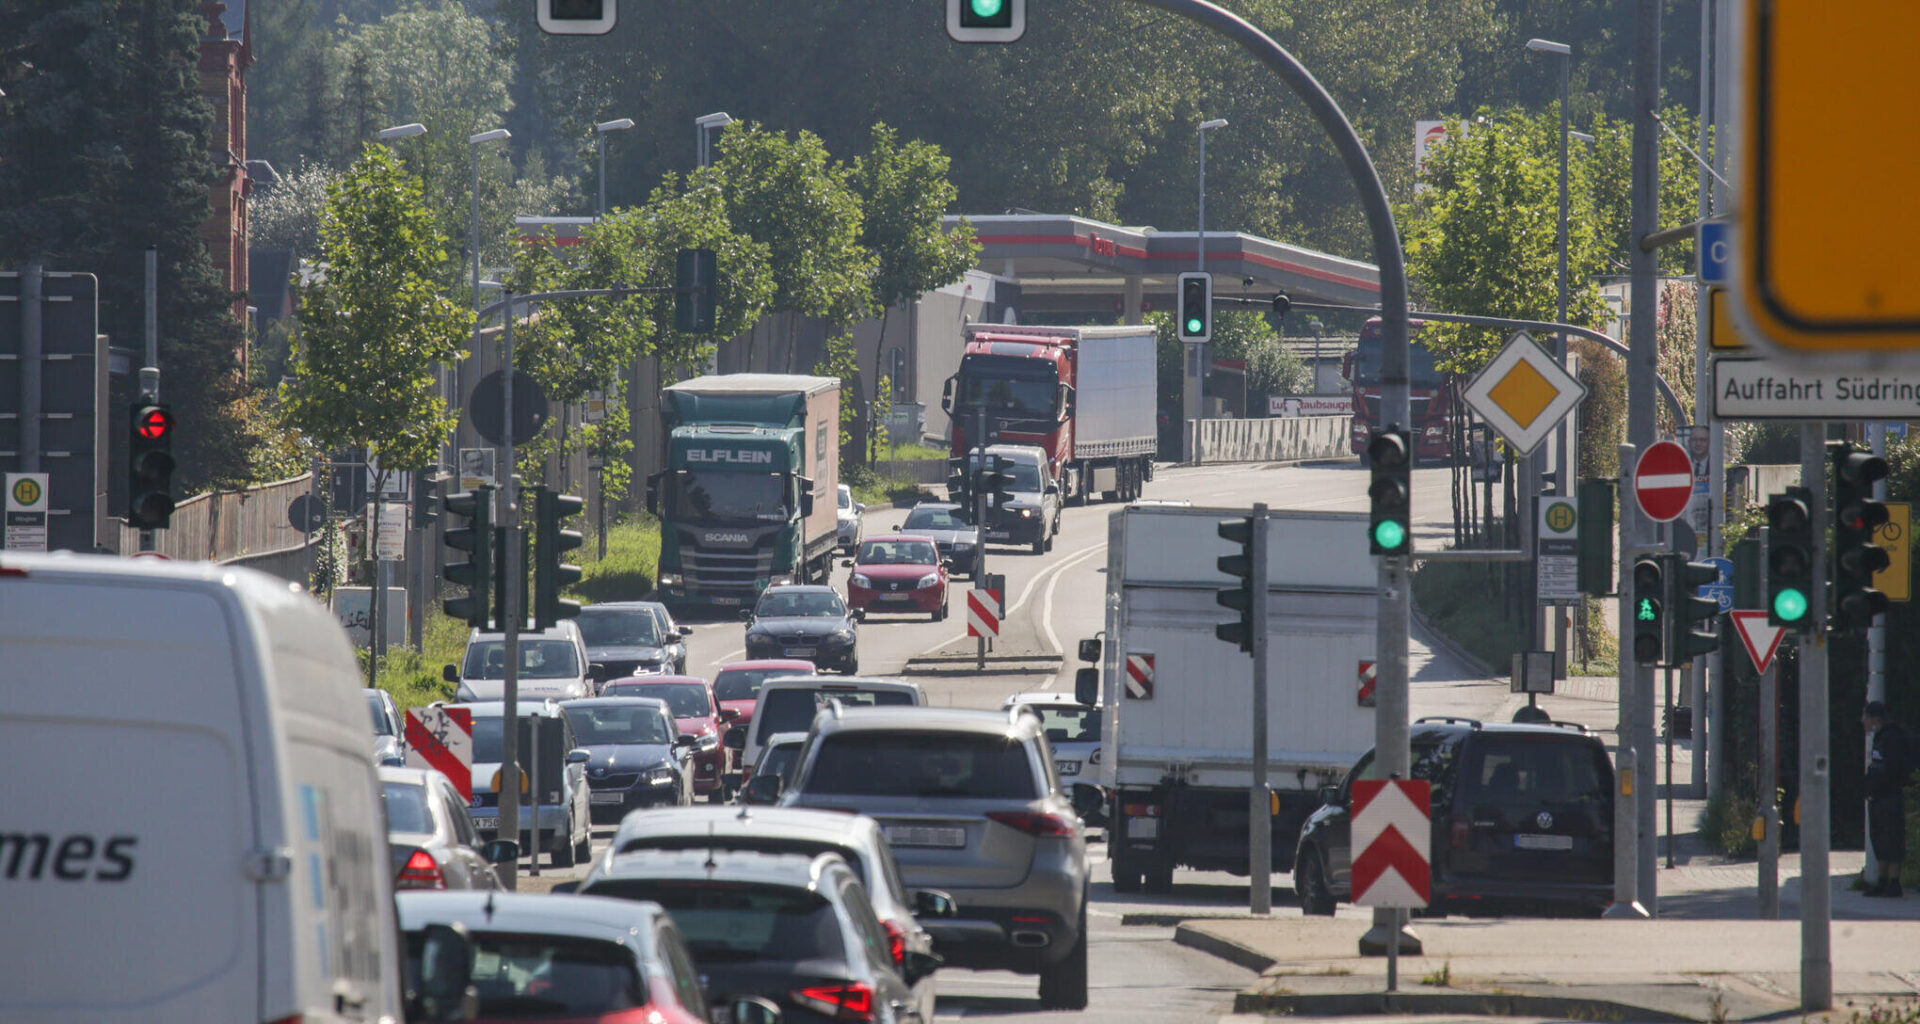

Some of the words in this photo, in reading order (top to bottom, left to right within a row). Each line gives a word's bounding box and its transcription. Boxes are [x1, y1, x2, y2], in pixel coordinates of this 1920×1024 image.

[1724, 377, 1824, 401] Auffahrt
[687, 449, 772, 463] ELFLEIN
[704, 533, 749, 542] SCANIA
